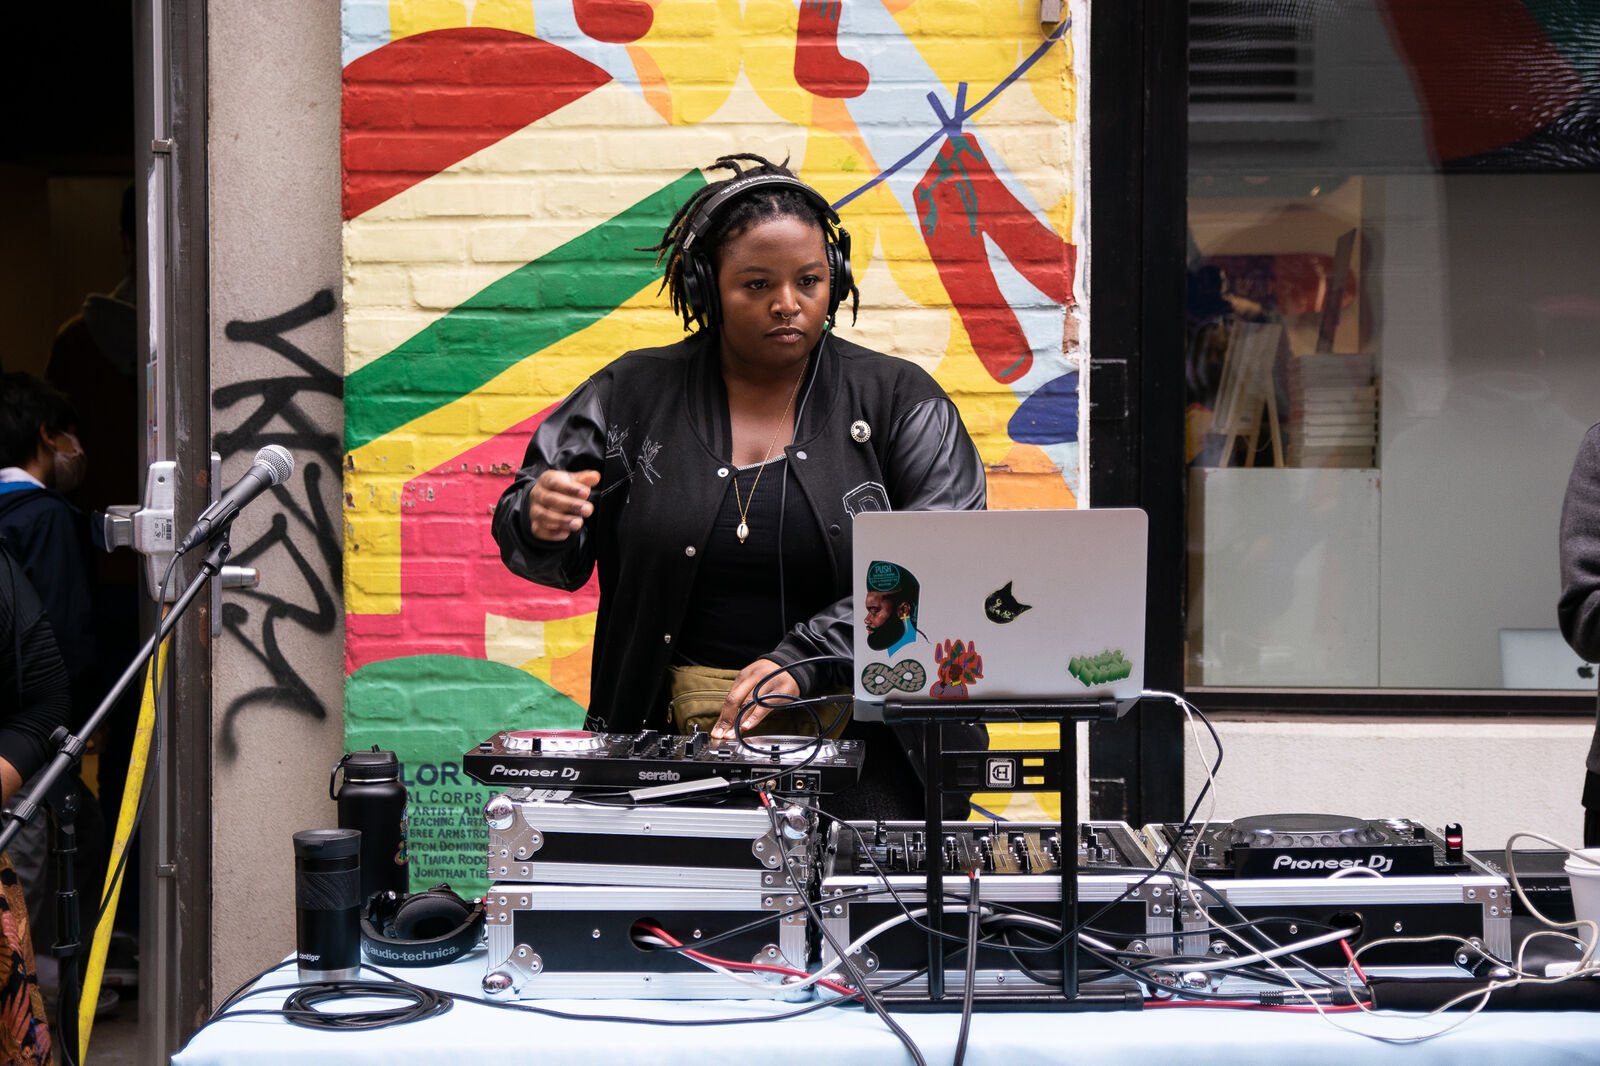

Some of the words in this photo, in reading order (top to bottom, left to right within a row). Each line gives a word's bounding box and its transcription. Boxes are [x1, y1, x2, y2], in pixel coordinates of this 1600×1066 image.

[875, 565, 892, 574] PUSH
[399, 762, 462, 786] LOR
[490, 764, 558, 777] Pioneer
[638, 769, 681, 782] serato
[407, 791, 422, 804] AL
[430, 789, 482, 804] CORPS
[462, 806, 484, 817] AN
[459, 815, 488, 827] ARTIS
[437, 828, 488, 839] ARMSTRO
[440, 841, 488, 852] DOMINIQU
[458, 854, 487, 865] RODG
[1273, 855, 1364, 870] Pioneer
[414, 867, 466, 879] JONATHAN
[469, 867, 486, 879] TIE
[371, 946, 457, 961] audio-technica
